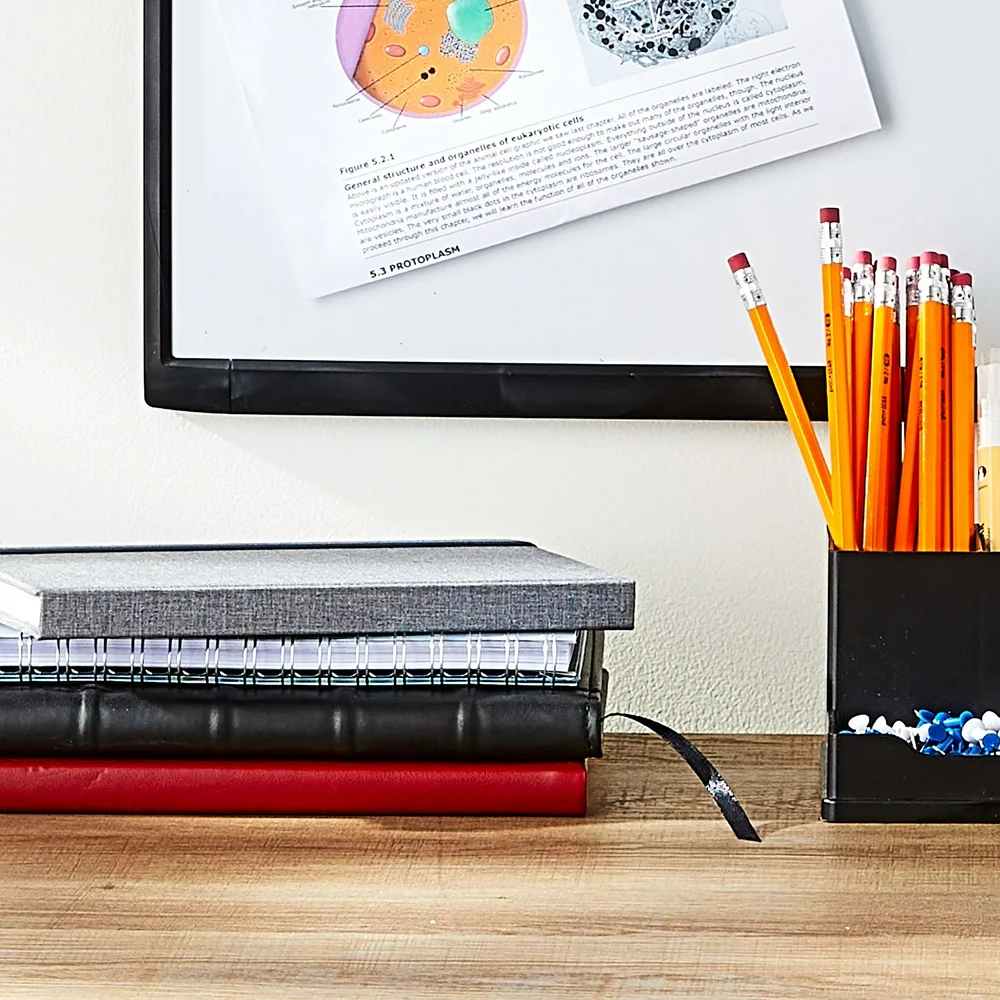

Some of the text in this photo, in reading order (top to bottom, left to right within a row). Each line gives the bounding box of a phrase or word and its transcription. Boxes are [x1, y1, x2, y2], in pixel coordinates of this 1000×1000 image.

[339, 153, 395, 175] Figure 5.2.1
[344, 116, 584, 191] General structure and organelles of eukaryotic cells
[370, 245, 460, 280] 5.3 PROTOPLASM
